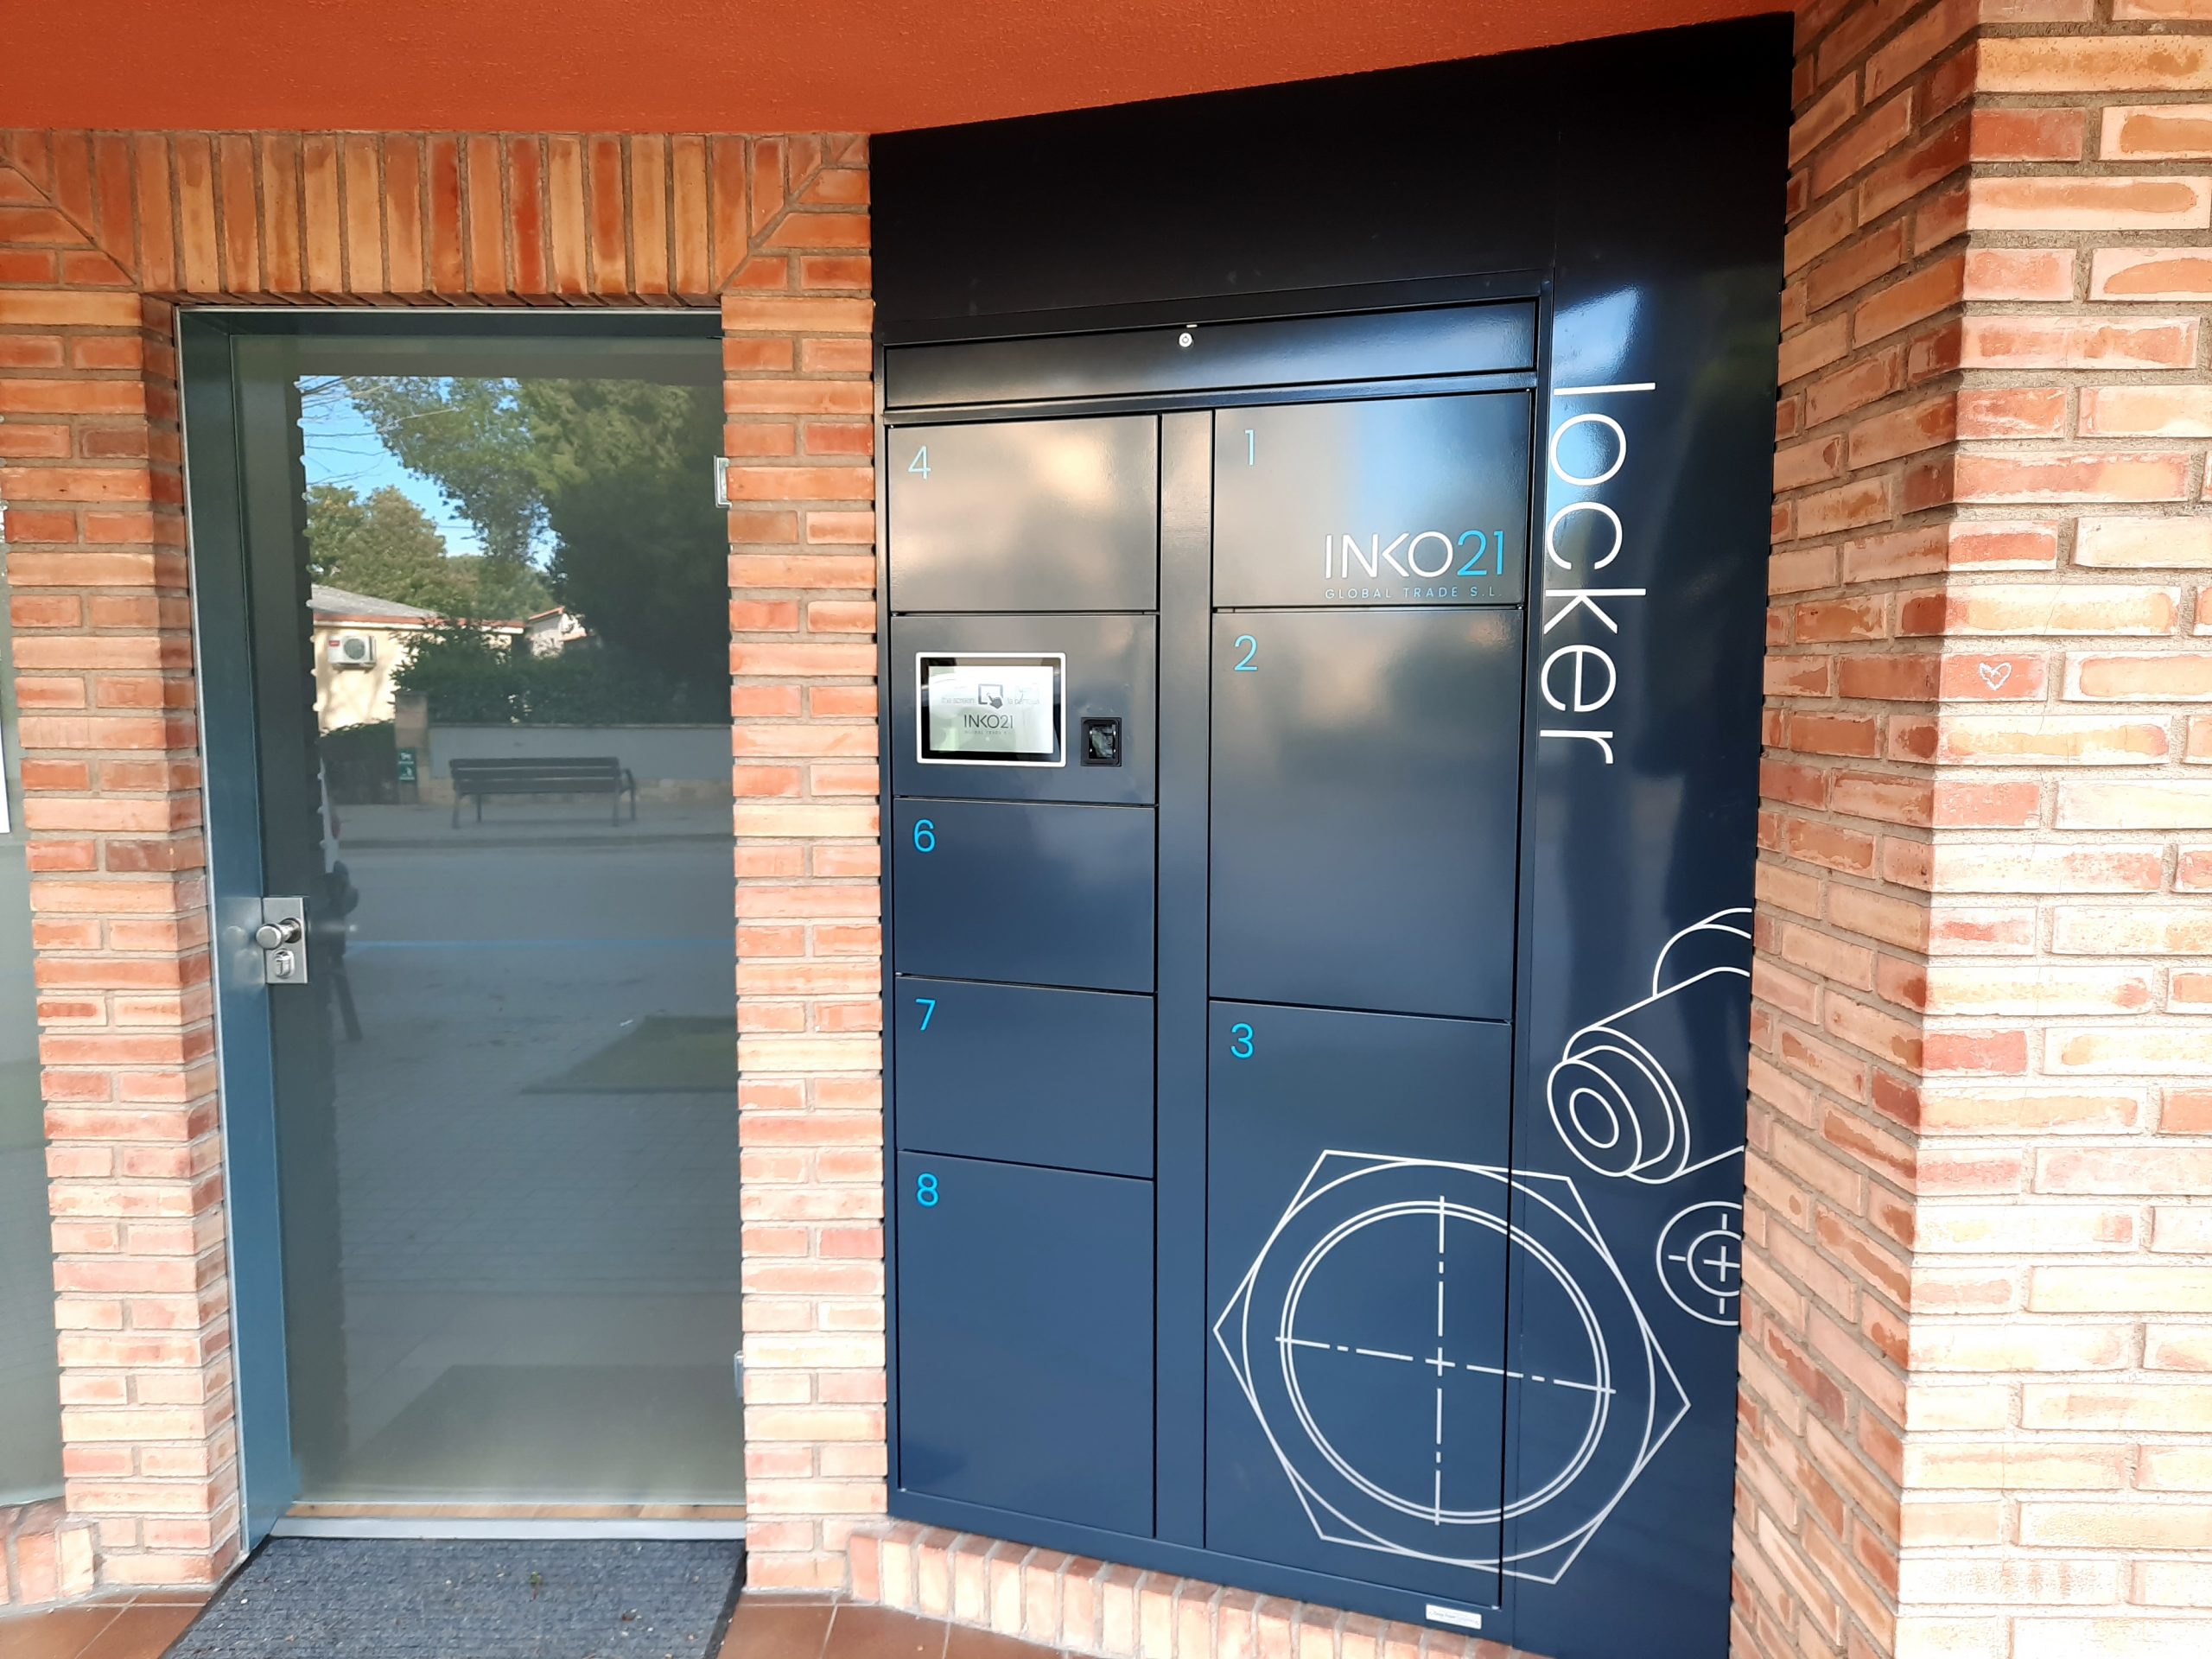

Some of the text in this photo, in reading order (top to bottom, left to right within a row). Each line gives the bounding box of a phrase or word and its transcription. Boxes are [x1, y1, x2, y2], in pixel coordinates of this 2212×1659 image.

[907, 445, 931, 480] 4
[1244, 429, 1256, 466] 1
[1325, 530, 1505, 580] INKO21
[1539, 382, 1656, 766] locker
[1325, 586, 1503, 600] GLOBAL TRADE S.L.
[1234, 635, 1258, 671] 2
[963, 714, 1014, 728] INKO21
[912, 818, 936, 853] 6
[915, 998, 936, 1031] 7
[1230, 1022, 1255, 1059] 3
[916, 1173, 939, 1208] 8
